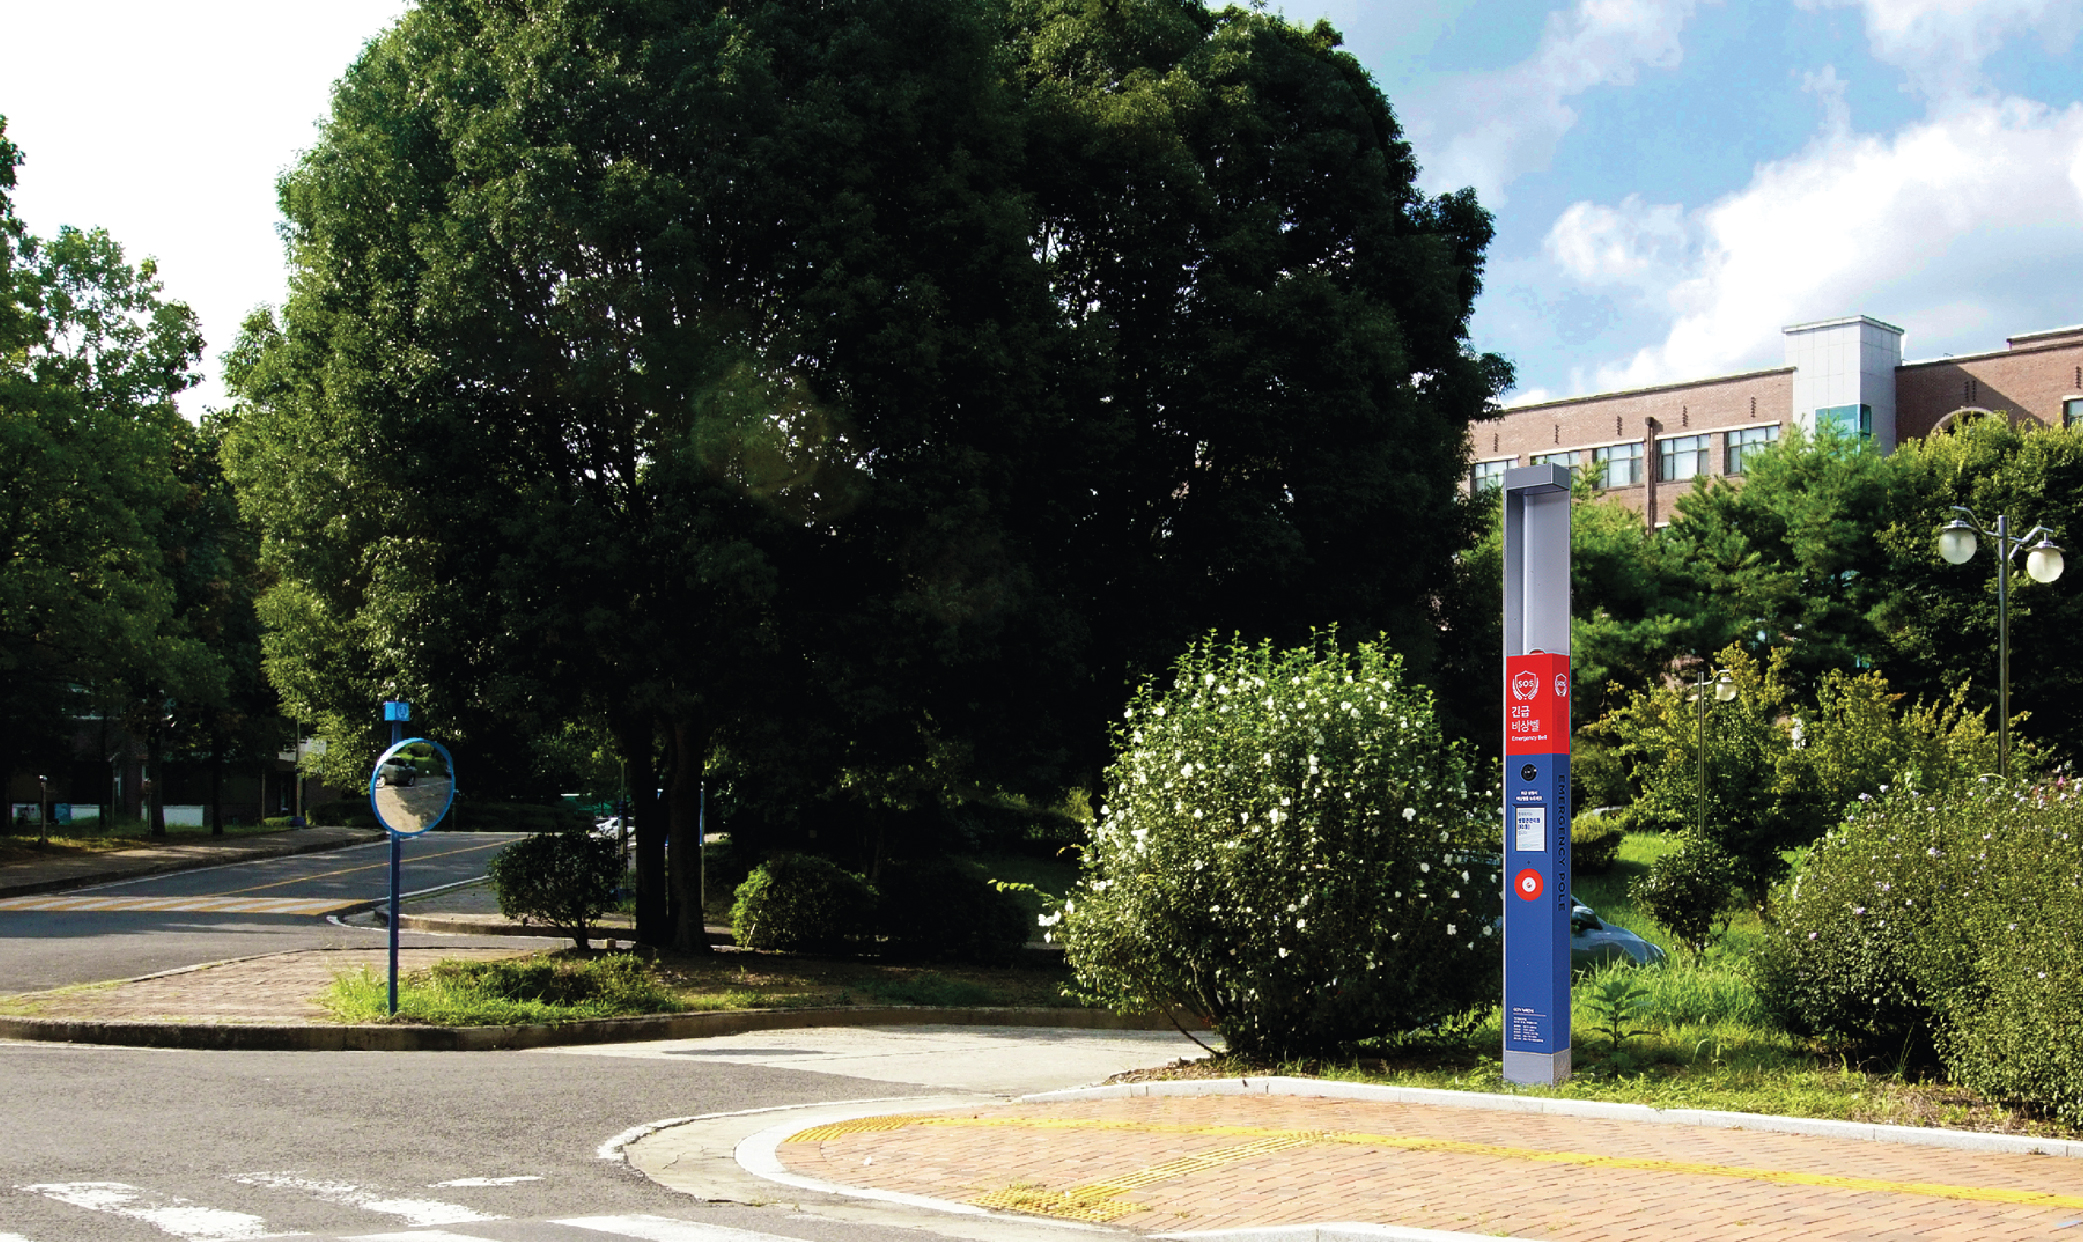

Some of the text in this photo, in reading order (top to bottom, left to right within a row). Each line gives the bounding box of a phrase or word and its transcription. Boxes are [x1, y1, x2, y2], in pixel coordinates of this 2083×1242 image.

[1518, 680, 1534, 688] SOS
[1511, 706, 1530, 718] 긴급
[1511, 720, 1540, 732] 비상벨
[1558, 774, 1566, 911] EMERGENCY POLE
